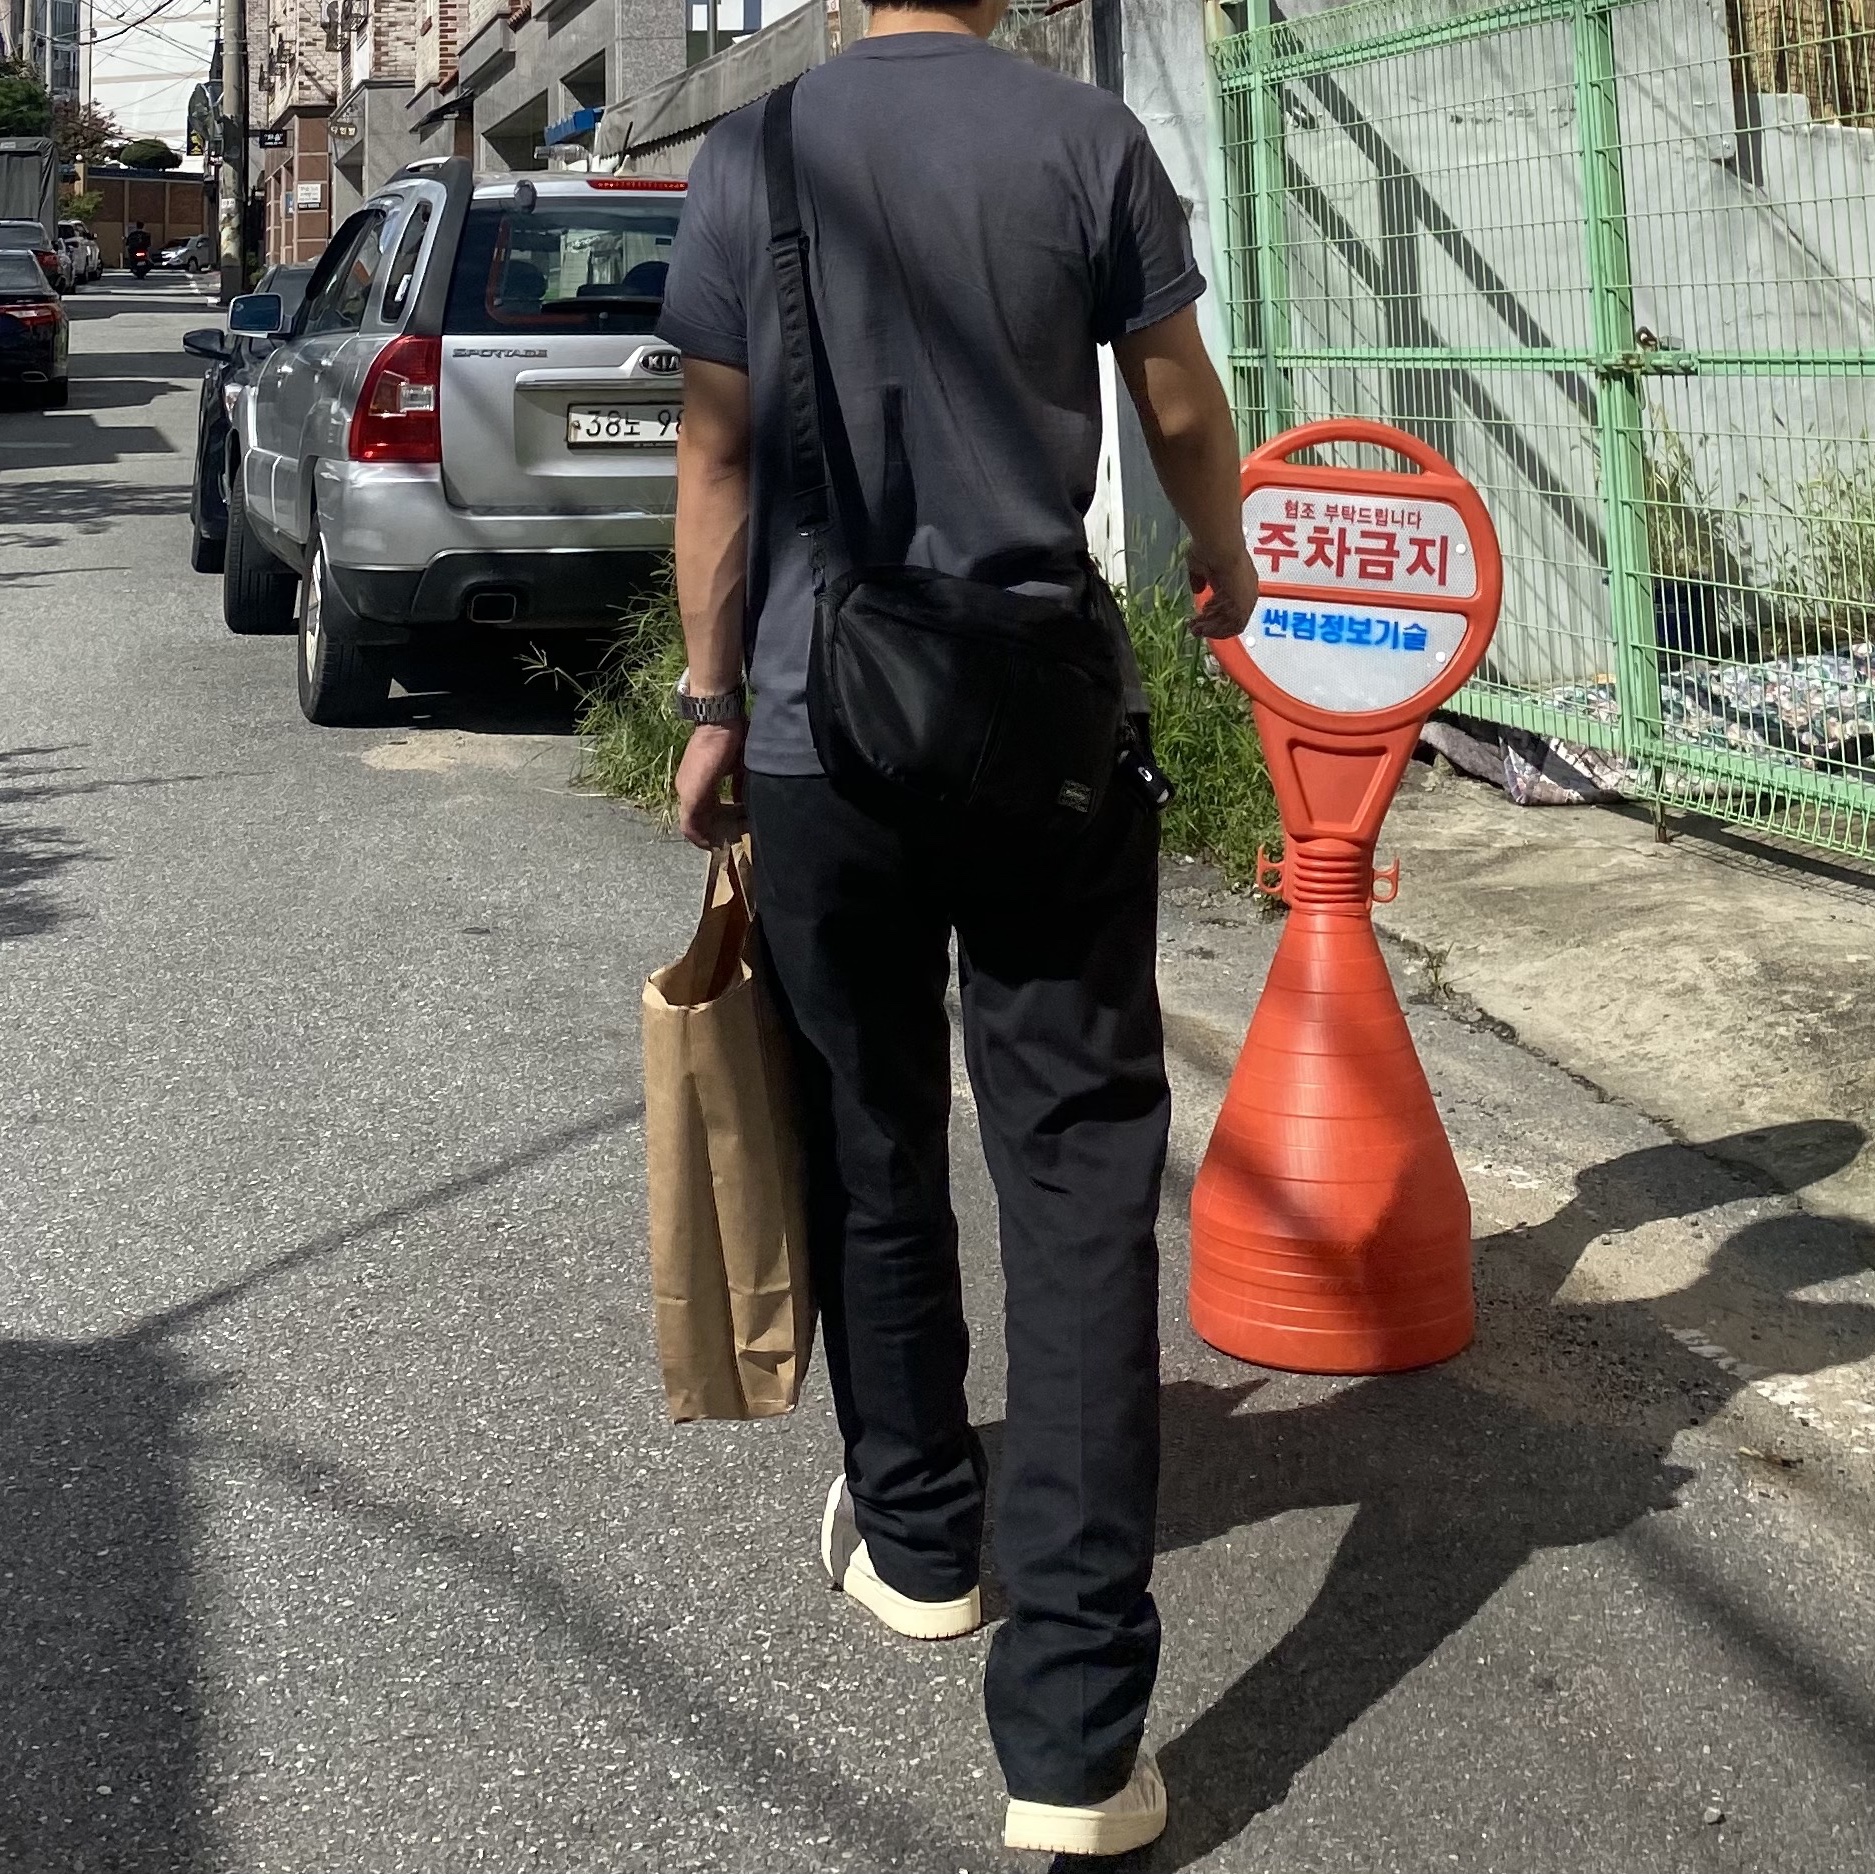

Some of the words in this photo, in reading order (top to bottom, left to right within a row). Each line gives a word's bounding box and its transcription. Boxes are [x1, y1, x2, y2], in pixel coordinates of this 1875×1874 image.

[647, 355, 680, 369] KIA
[586, 409, 641, 437] 38노
[1284, 498, 1316, 520] 협조
[1324, 503, 1423, 530] 부탁드립니다
[1253, 520, 1449, 587] 주차금지
[1261, 607, 1428, 652] 썬컴정보기술
